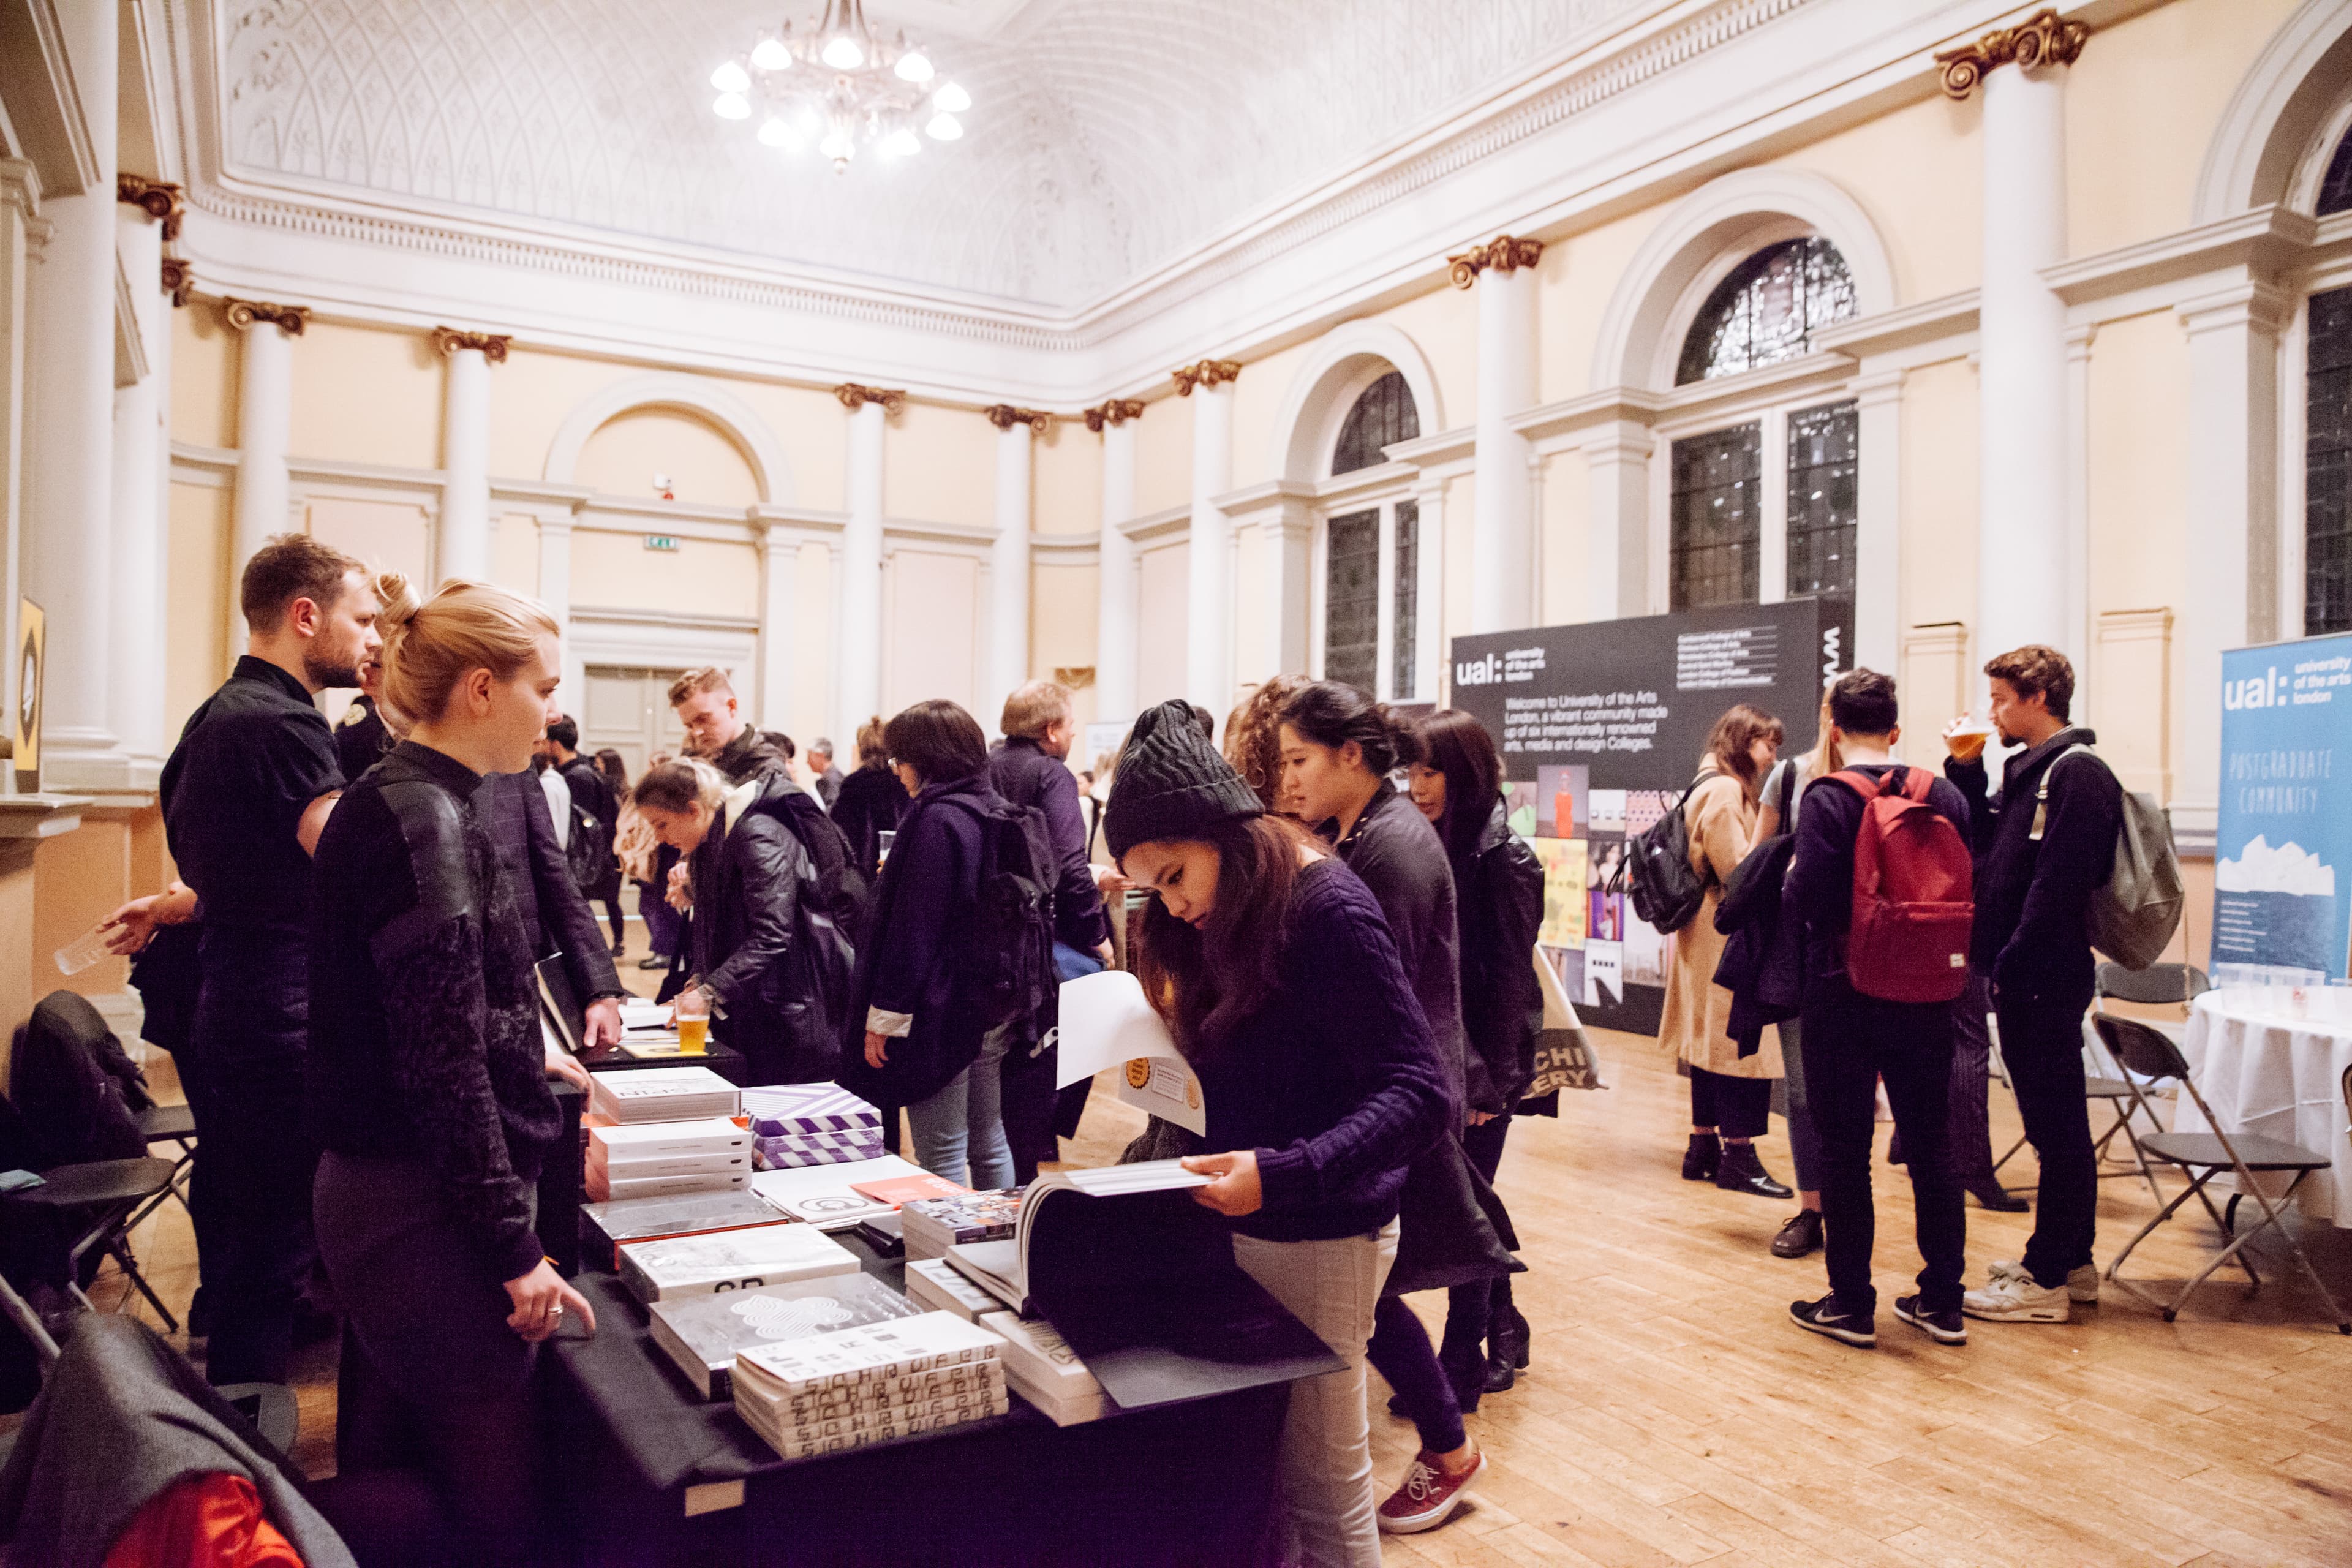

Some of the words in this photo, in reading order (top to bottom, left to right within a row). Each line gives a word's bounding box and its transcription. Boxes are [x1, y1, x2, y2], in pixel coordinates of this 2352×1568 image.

[1456, 652, 1503, 686] ual:
[2294, 655, 2351, 674] university
[2224, 666, 2288, 711] ual:
[2294, 676, 2306, 690] of
[2307, 675, 2326, 688] the
[2327, 673, 2352, 686] arts
[2293, 690, 2332, 705] london
[2229, 748, 2333, 780] POSTGRADUATE
[2239, 786, 2318, 815] COMMUNITY
